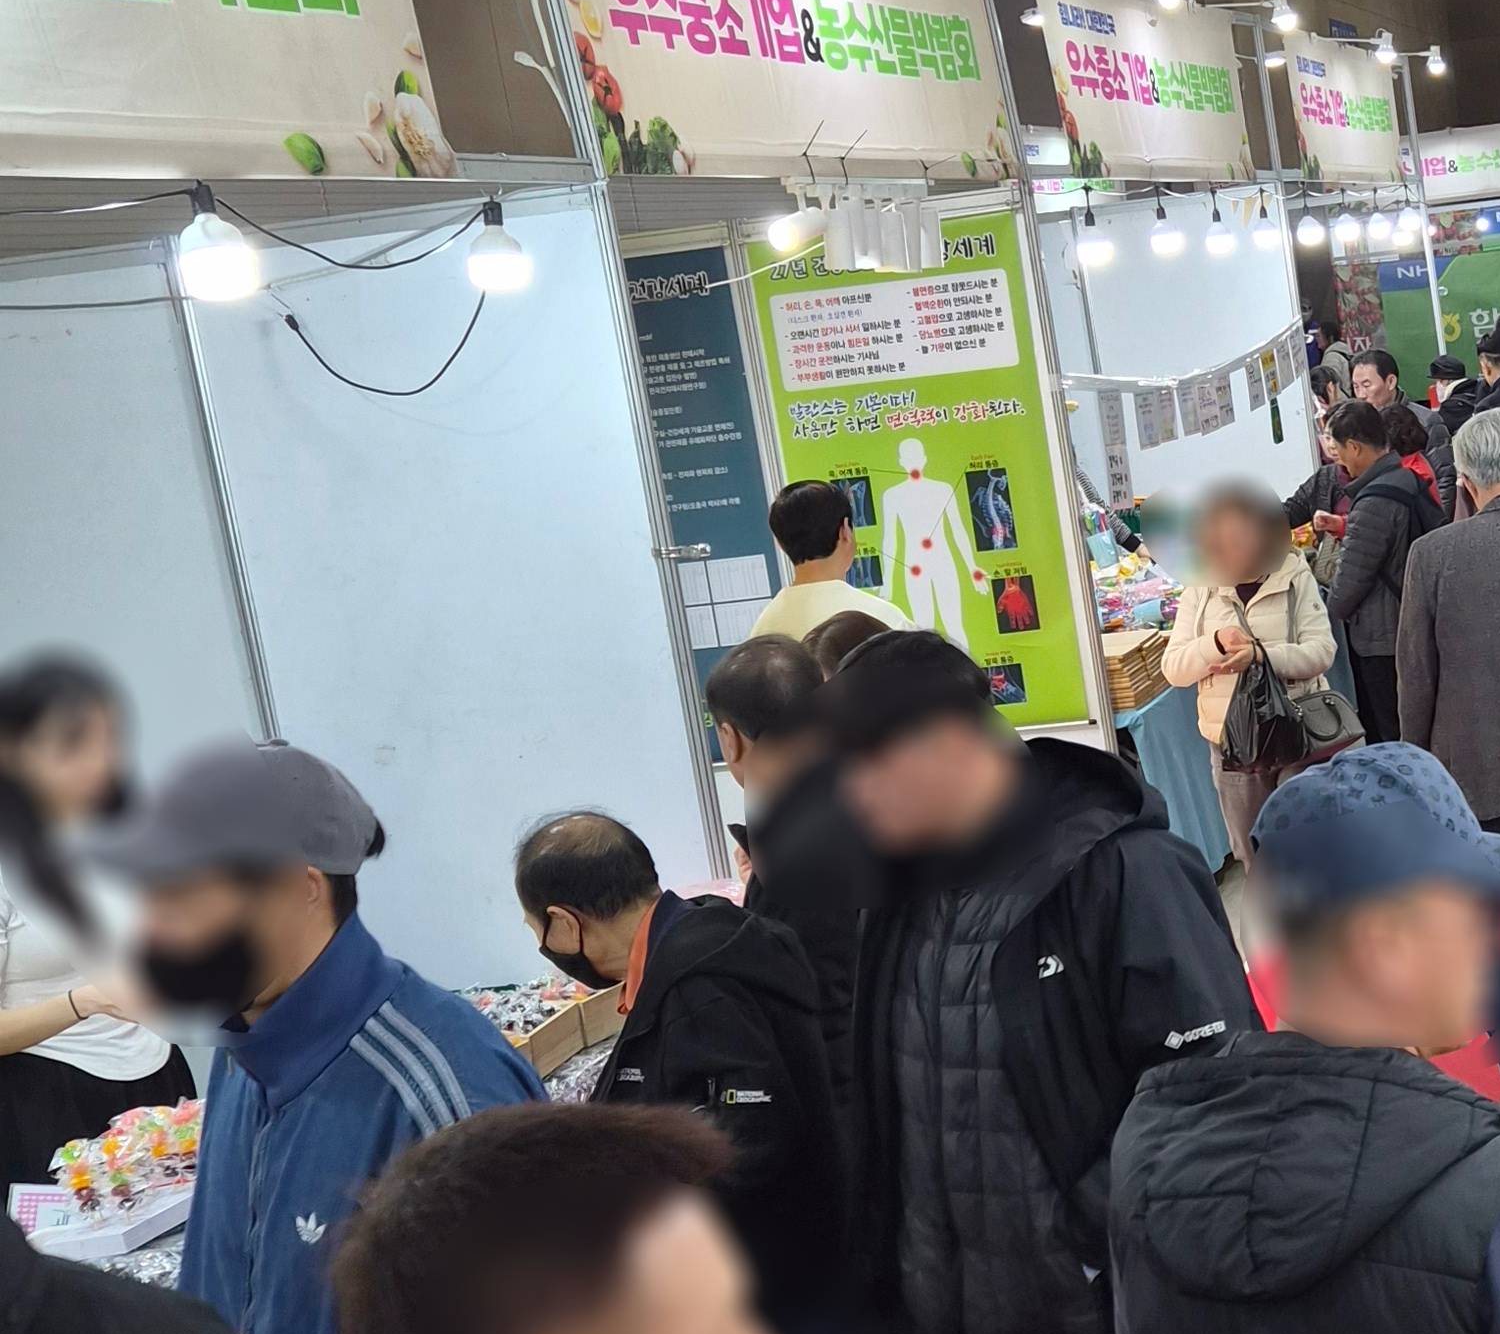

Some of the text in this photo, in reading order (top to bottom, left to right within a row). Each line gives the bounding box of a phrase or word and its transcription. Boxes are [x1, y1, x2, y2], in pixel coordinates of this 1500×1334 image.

[854, 391, 916, 413] 기본이다!
[793, 398, 1026, 440] 사용만 하면 면역력이 강화된다.
